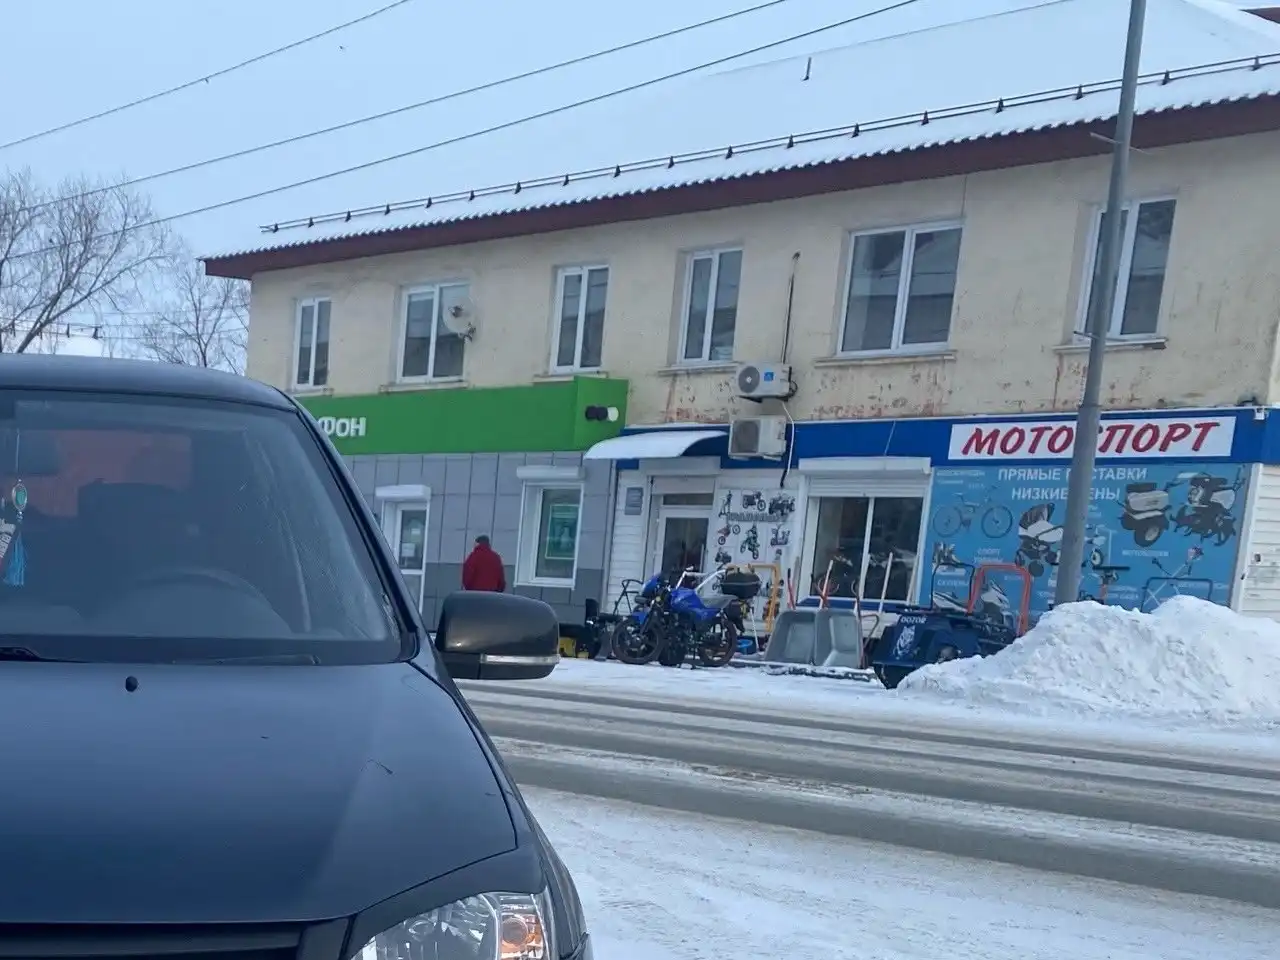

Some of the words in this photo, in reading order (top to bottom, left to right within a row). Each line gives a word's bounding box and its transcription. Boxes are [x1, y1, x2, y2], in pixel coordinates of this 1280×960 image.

[961, 422, 1220, 456] МОТОПОРТ
[998, 468, 1061, 481] ПРЯМЫЕ
[1011, 487, 1068, 500] НИЗКИЕ
[1074, 486, 1120, 500] ЕНЫ
